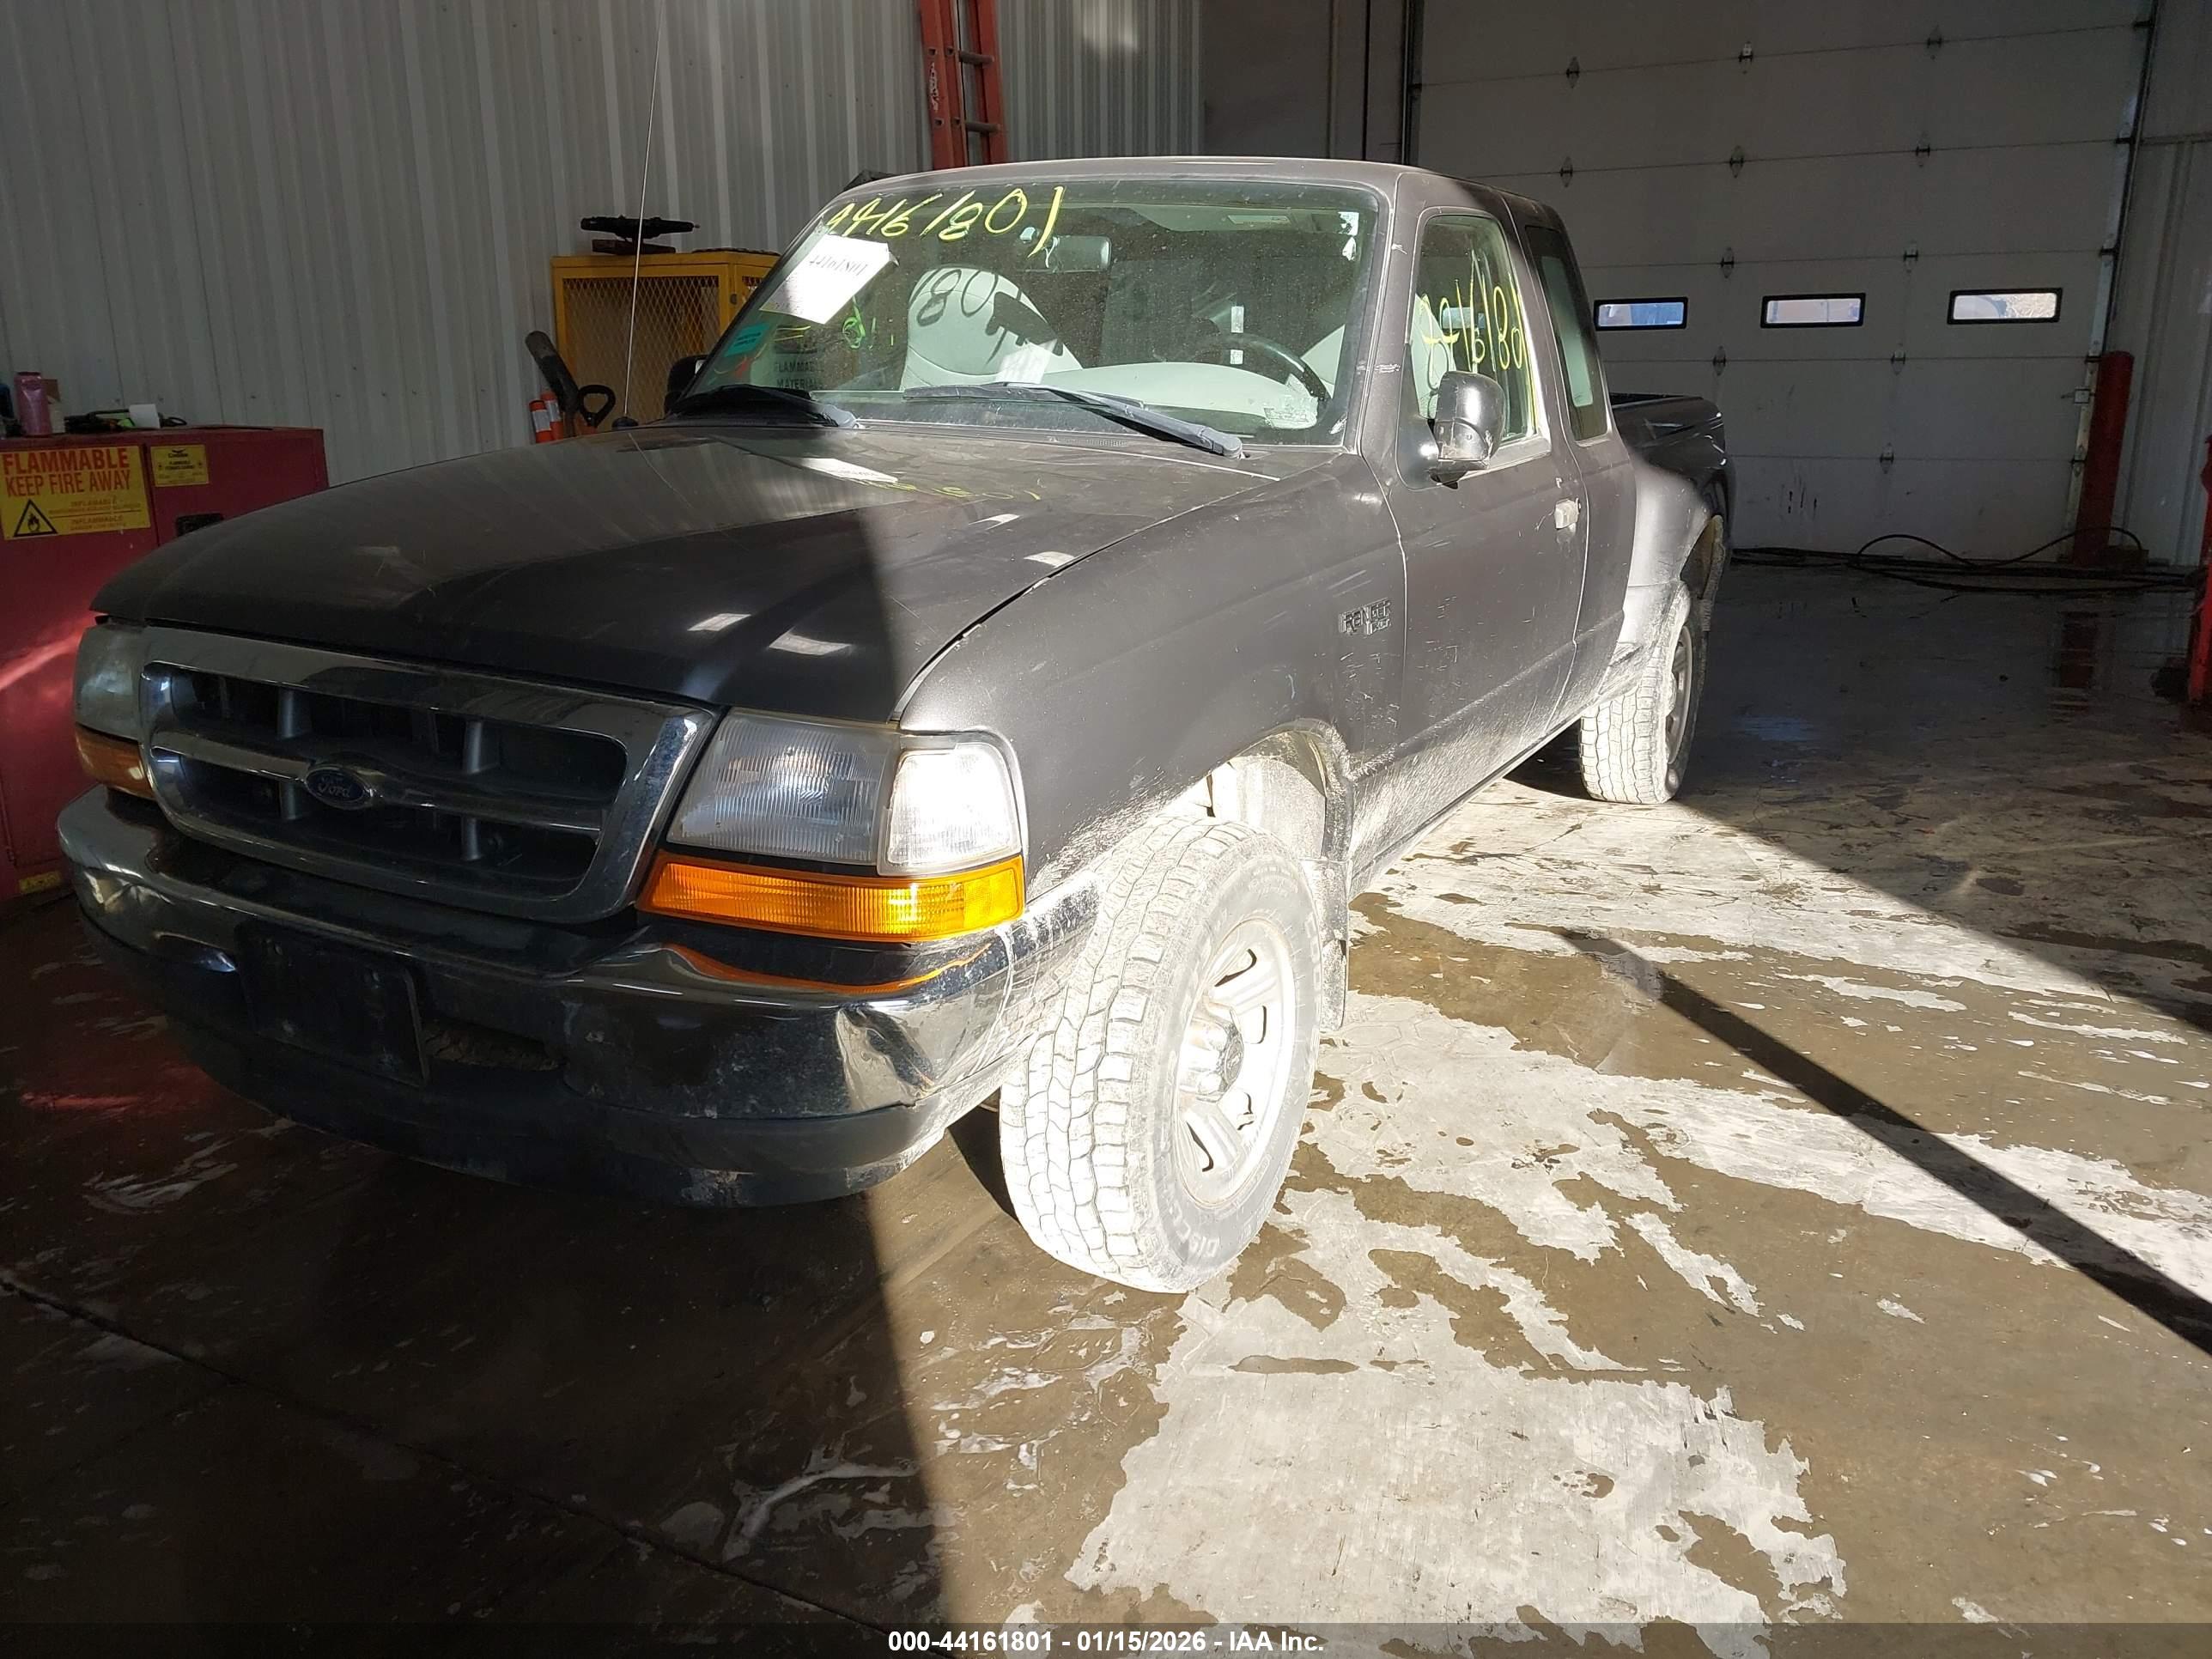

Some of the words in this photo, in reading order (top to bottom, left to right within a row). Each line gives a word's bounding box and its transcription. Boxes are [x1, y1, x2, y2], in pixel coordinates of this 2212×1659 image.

[2, 447, 130, 475] FLAMMABLE
[5, 475, 44, 498] KEEP
[49, 471, 85, 495] FIRE
[89, 469, 131, 492] AWAY
[316, 780, 352, 799] Ford
